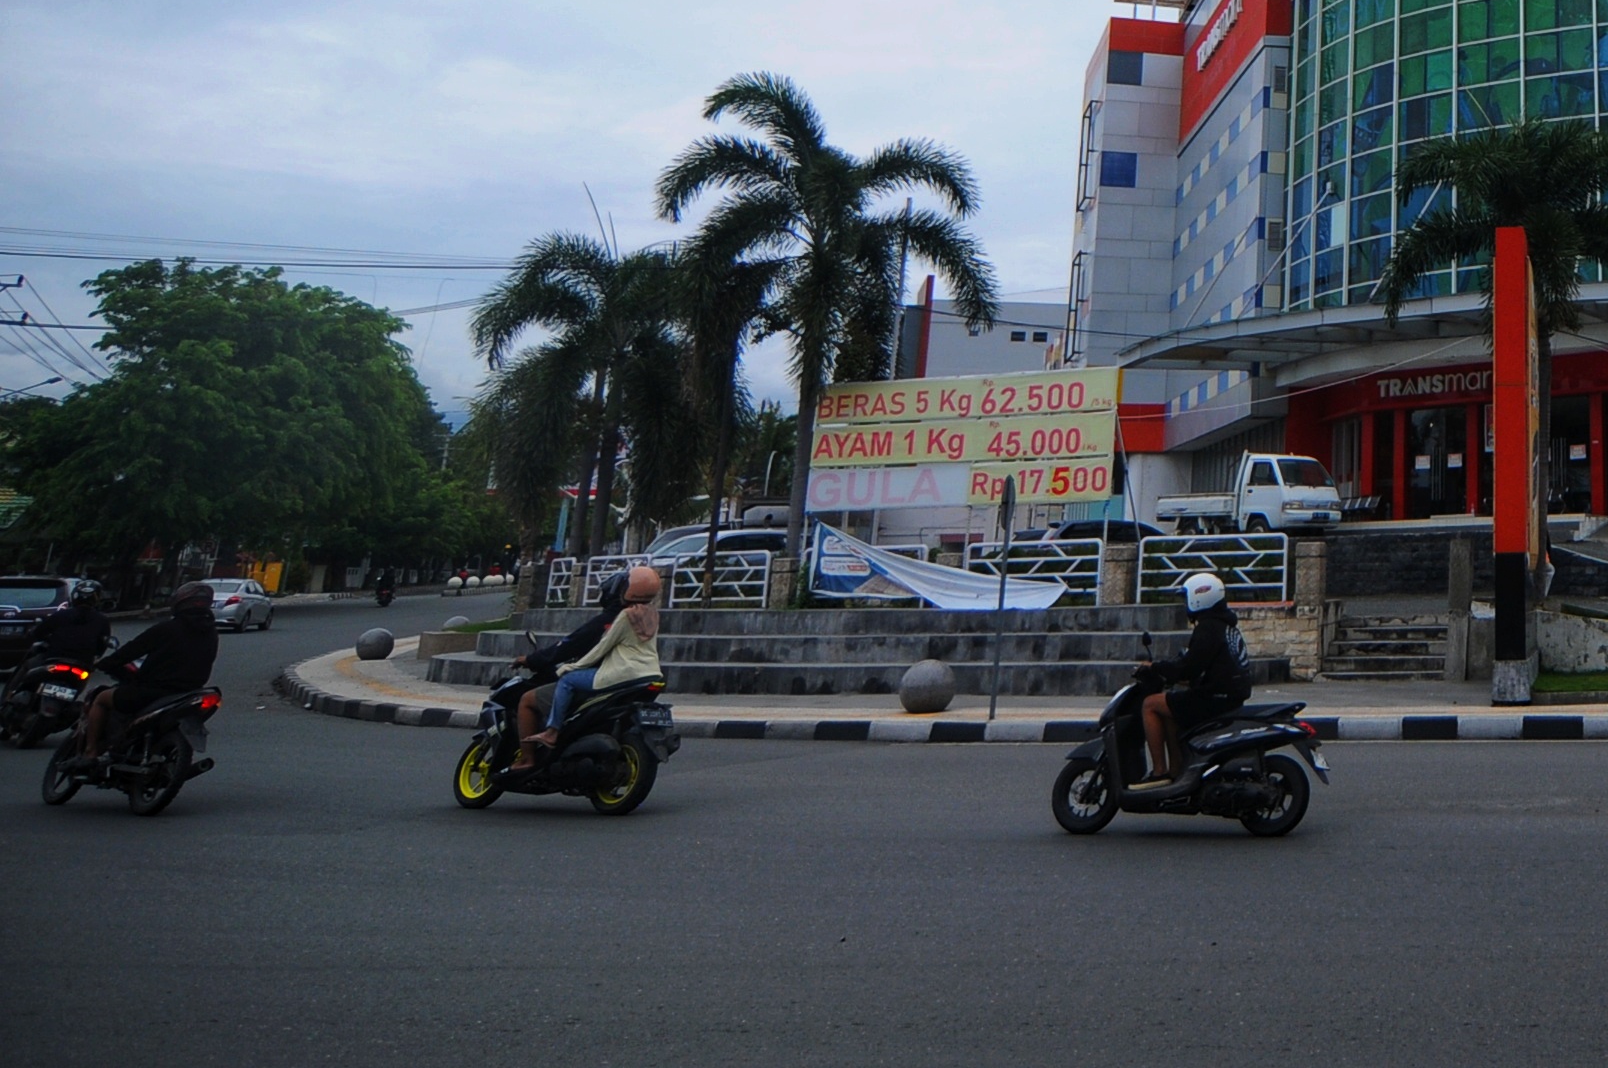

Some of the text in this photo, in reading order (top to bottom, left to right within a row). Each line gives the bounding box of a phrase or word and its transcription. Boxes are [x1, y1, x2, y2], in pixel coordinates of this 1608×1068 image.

[818, 392, 906, 420] BERAS
[915, 390, 930, 414] 5
[939, 388, 972, 417] Kg
[980, 381, 1085, 415] 62.500
[1377, 370, 1493, 398] TRANSmar
[813, 430, 893, 460] AYAM
[904, 429, 915, 456] 1
[926, 428, 965, 461] Kg
[987, 427, 1082, 457] 45.000
[809, 466, 1107, 508] GULA Rp 17.500
